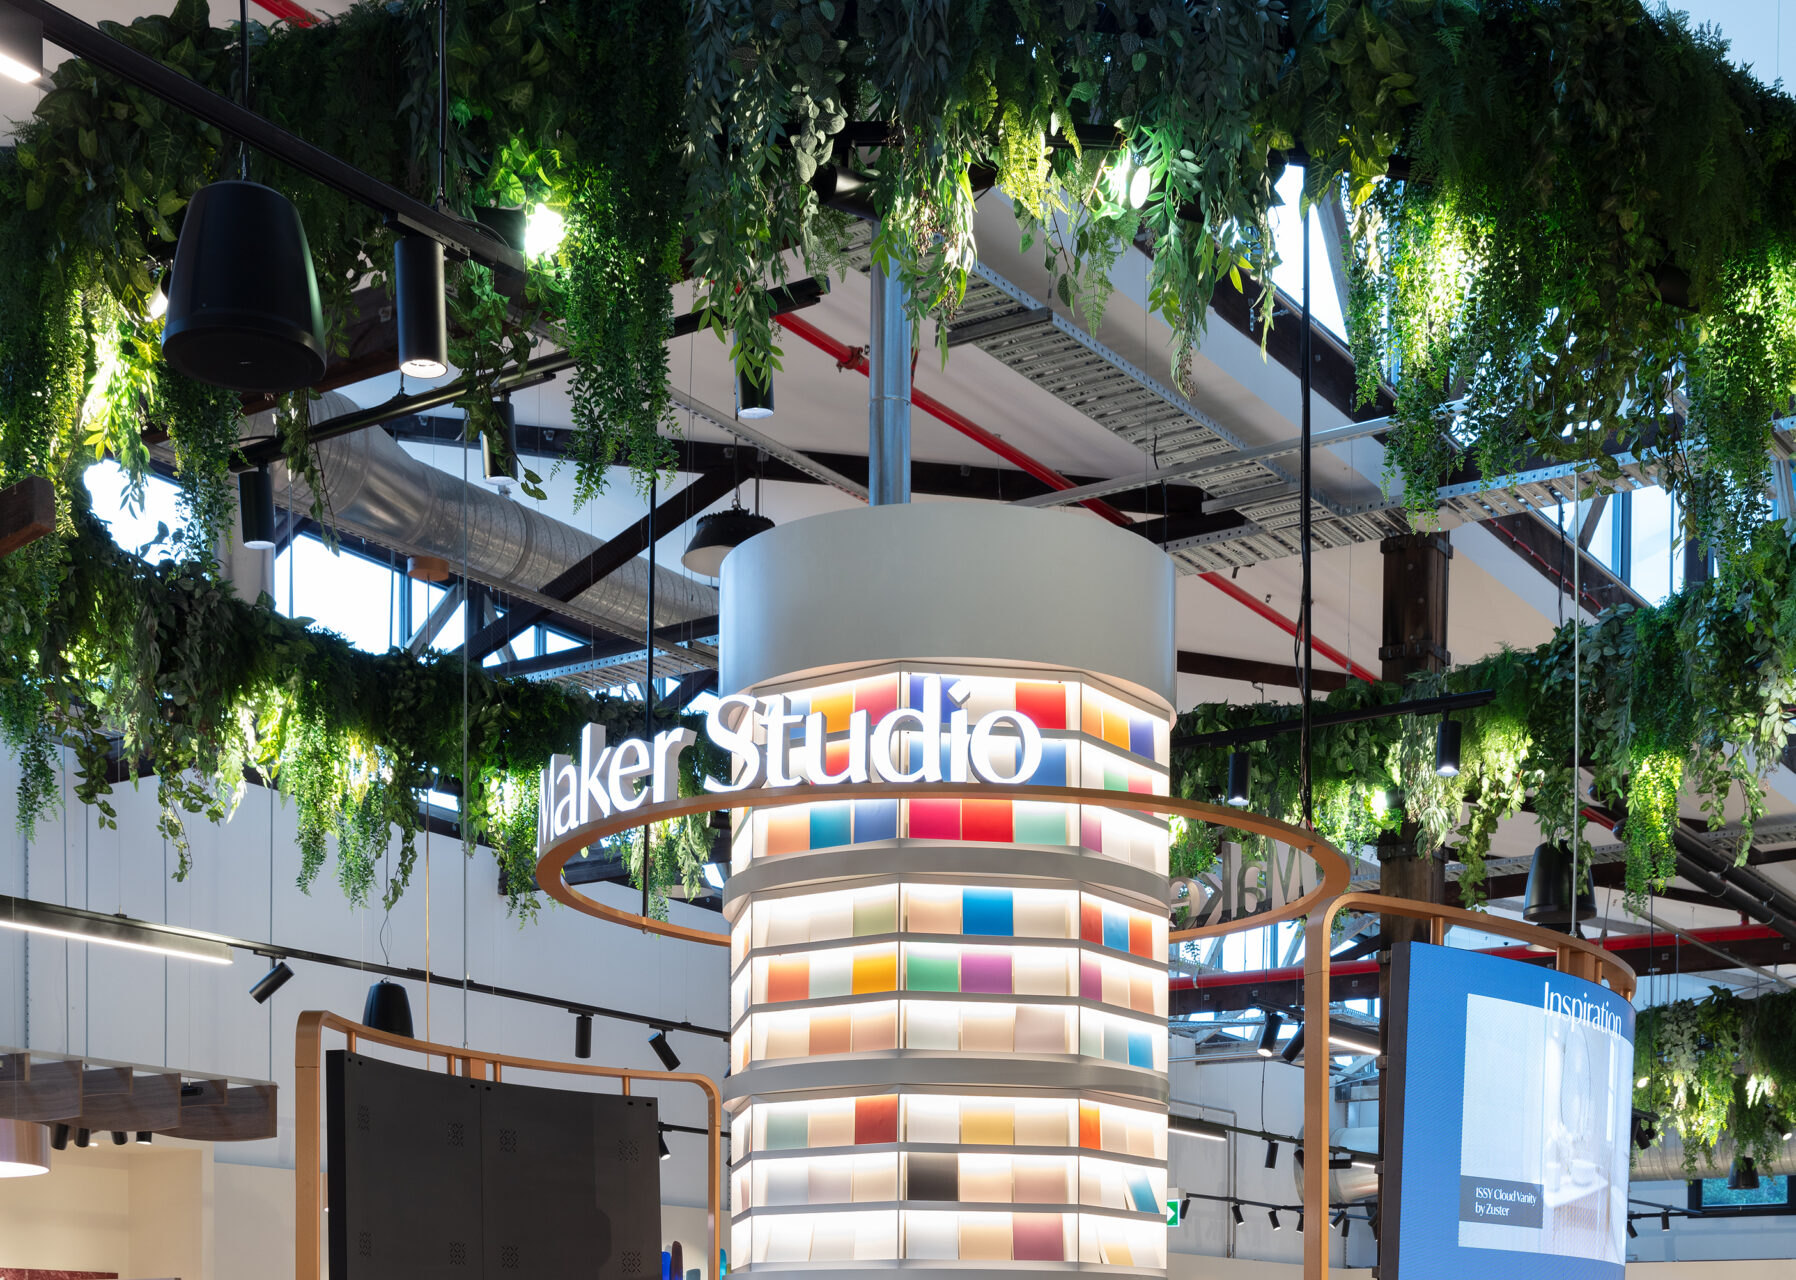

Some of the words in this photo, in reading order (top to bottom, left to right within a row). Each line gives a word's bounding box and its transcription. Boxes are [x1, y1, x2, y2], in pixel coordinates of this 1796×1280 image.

[537, 722, 690, 858] Maker
[703, 675, 1043, 793] Studio
[1544, 982, 1622, 1040] Inspiration
[1475, 1187, 1493, 1199] ISSY
[1494, 1189, 1516, 1201] Cloud
[1517, 1191, 1537, 1207] Vanity
[1475, 1201, 1485, 1216] by
[1486, 1203, 1510, 1216] Zuster
